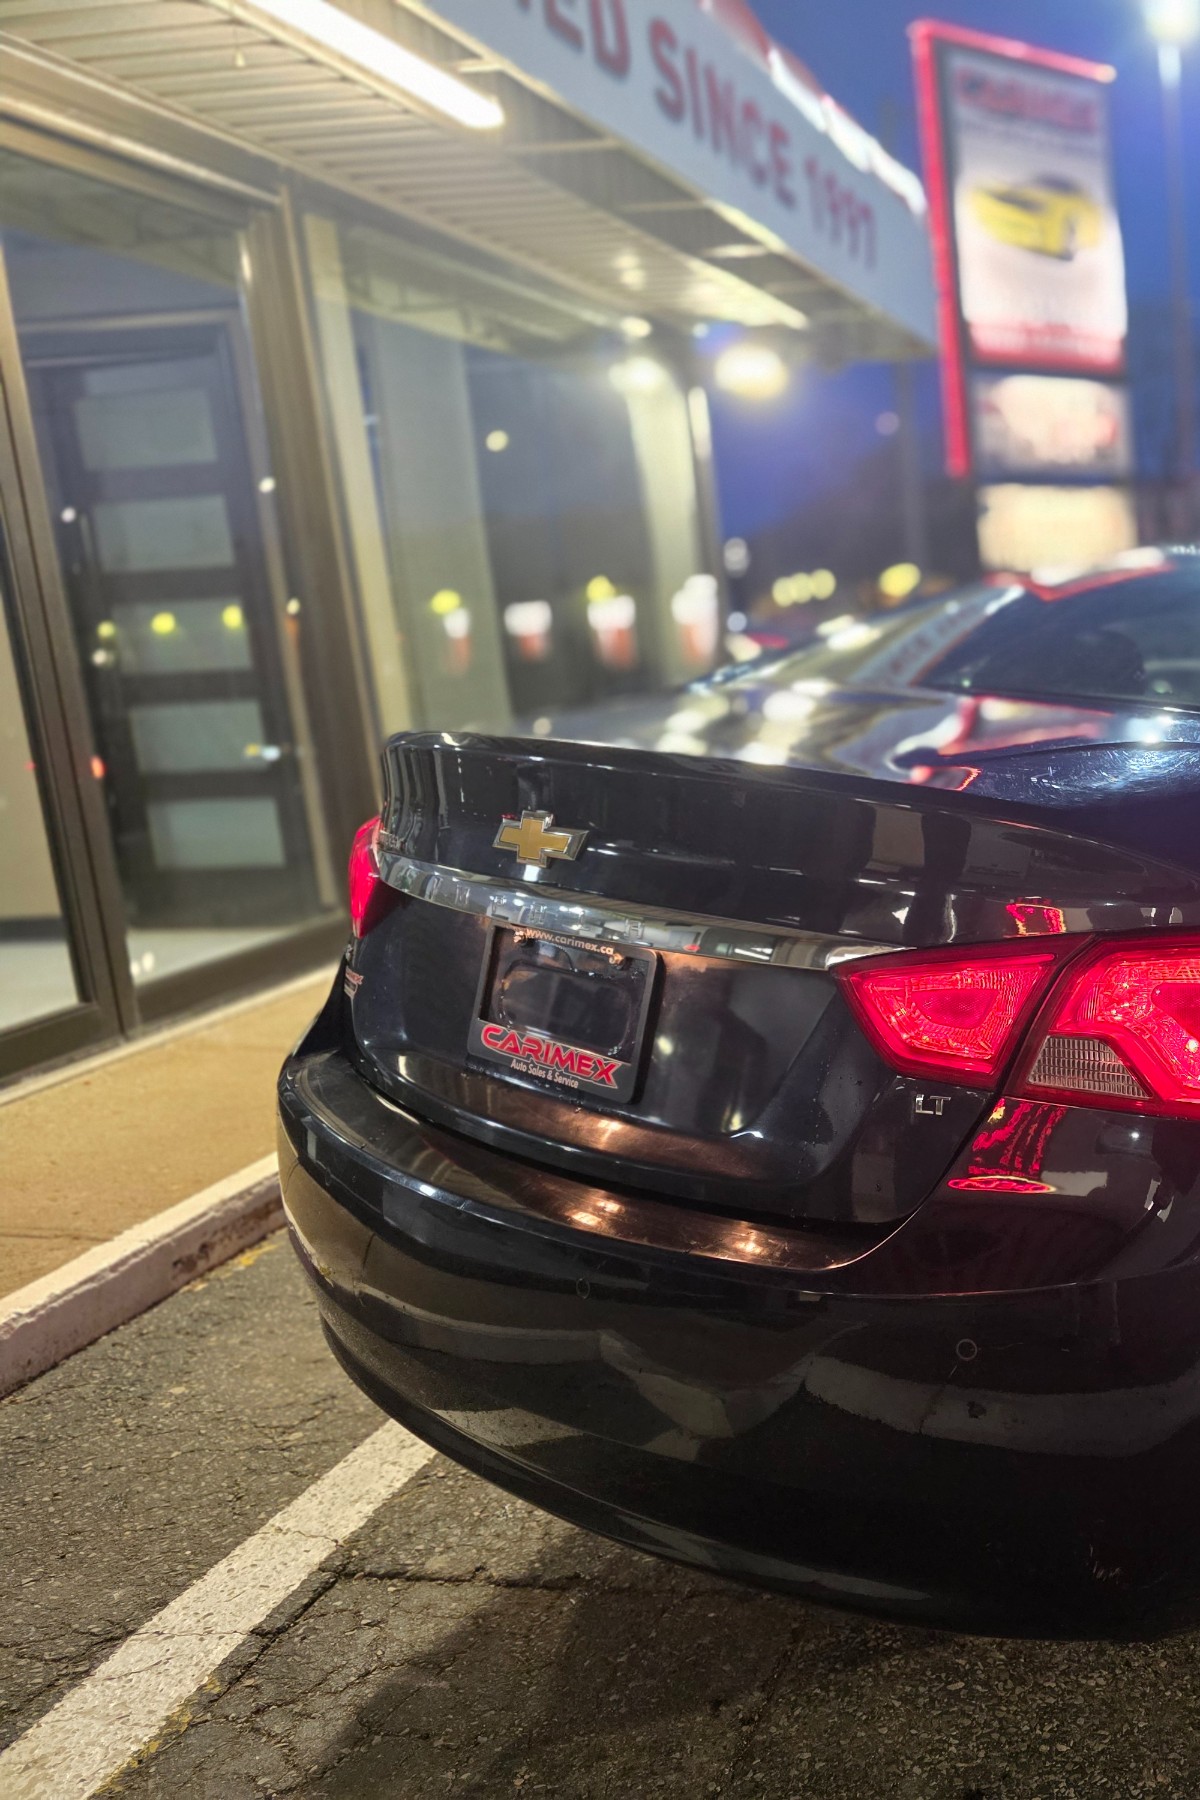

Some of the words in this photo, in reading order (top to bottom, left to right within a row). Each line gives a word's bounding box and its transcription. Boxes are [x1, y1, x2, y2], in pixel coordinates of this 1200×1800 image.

[648, 17, 796, 210] SINCE
[524, 928, 614, 955] www.carimex.ca
[480, 1024, 621, 1089] CARIMEX
[510, 1058, 527, 1072] Auto
[527, 1064, 546, 1079] Sales
[546, 1070, 553, 1081] &
[553, 1073, 579, 1089] Service
[915, 1093, 952, 1116] LT
